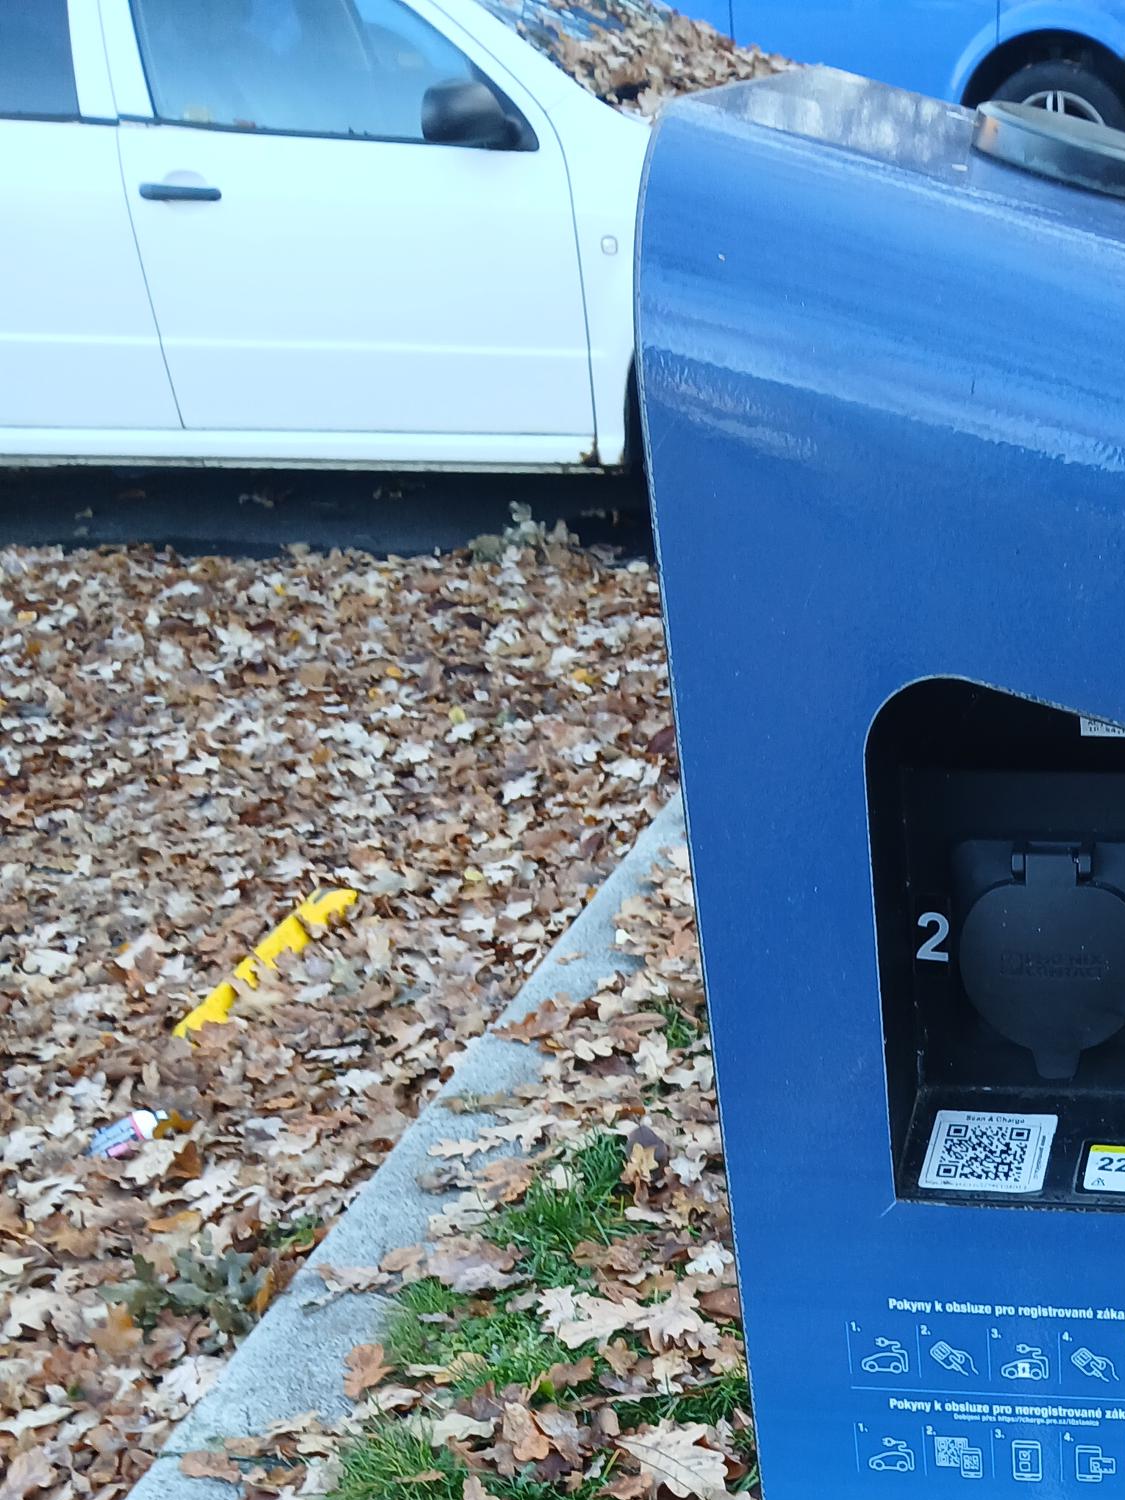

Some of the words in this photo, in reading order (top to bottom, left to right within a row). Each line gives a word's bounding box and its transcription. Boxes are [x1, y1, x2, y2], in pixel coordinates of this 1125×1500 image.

[916, 911, 950, 963] 2
[888, 1298, 932, 1314] Pokyny
[934, 1301, 943, 1312] k
[945, 1302, 992, 1314] obsluze
[994, 1306, 1015, 1317] pro
[1018, 1306, 1093, 1319] registrované
[850, 1321, 861, 1332] 1.
[920, 1325, 932, 1336] 2.
[991, 1328, 1002, 1339] 3.
[1061, 1331, 1073, 1342] 4.
[889, 1398, 932, 1413] Pokyny
[934, 1400, 942, 1411] k
[945, 1401, 990, 1413] obsluze
[992, 1405, 1013, 1415] pro
[1015, 1405, 1102, 1418] neregistrované
[858, 1423, 868, 1433] 1.
[926, 1426, 936, 1436] 2.
[994, 1429, 1005, 1439] 3.
[1063, 1432, 1074, 1442] 4.
